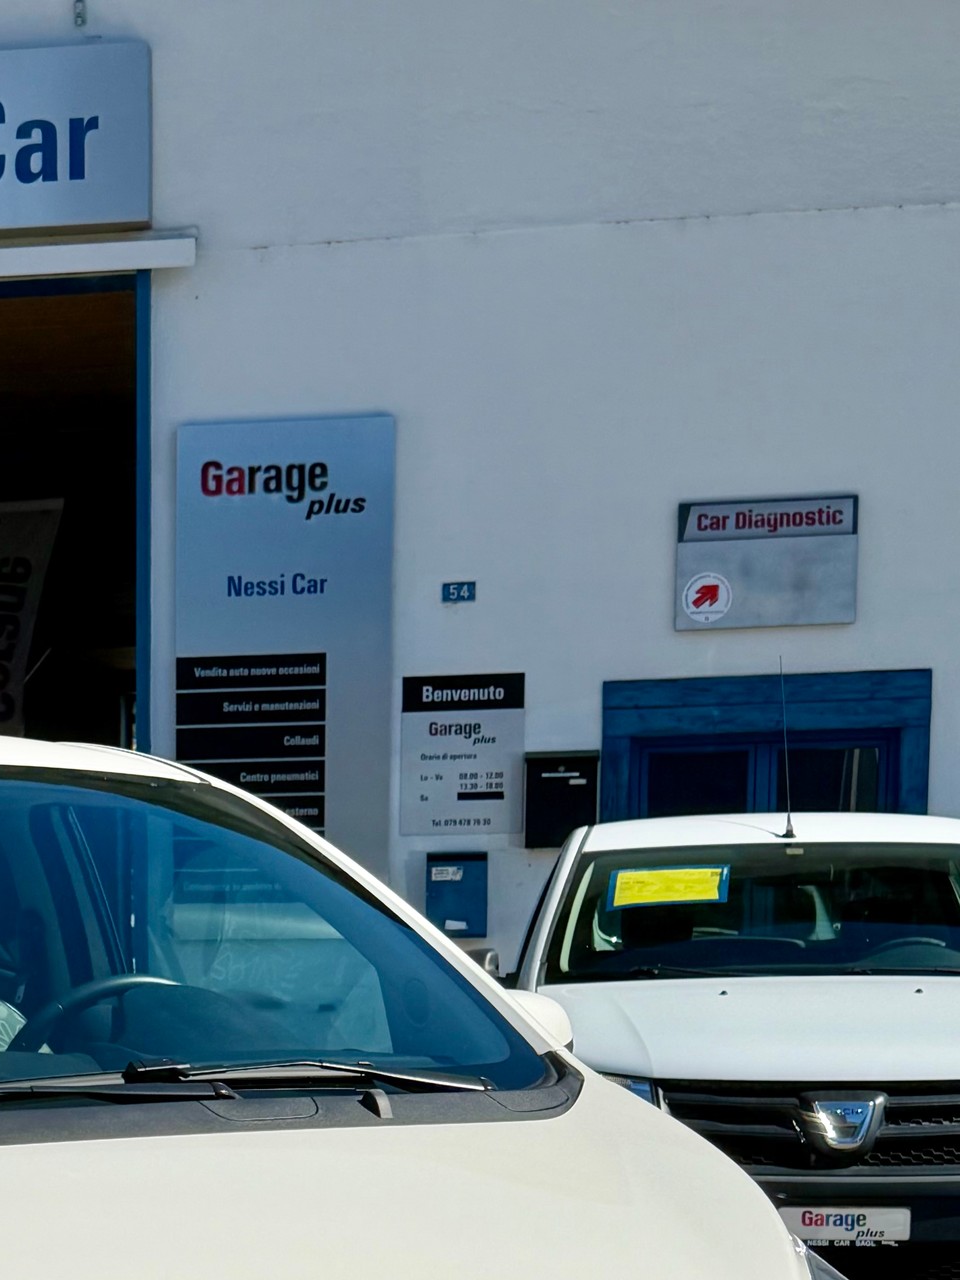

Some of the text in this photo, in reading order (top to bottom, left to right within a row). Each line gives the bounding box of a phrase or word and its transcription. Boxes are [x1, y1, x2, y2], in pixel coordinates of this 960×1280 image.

[200, 460, 329, 504] Garage
[304, 493, 366, 521] plus
[696, 505, 844, 534] Car Diagnostic
[227, 572, 328, 598] Nessi Car
[449, 584, 470, 600] 54
[194, 666, 228, 678] Vendita
[229, 667, 249, 677] auto
[278, 664, 320, 675] occasioni
[422, 685, 505, 703] Benvenuto
[223, 699, 320, 713] Servizi e manutenzioni
[428, 720, 482, 740] Garage
[283, 734, 320, 746] Collaudi
[472, 734, 497, 747] plus
[240, 770, 319, 784] Centro pneumatici
[801, 1210, 867, 1232] Garage
[855, 1228, 886, 1240] plus
